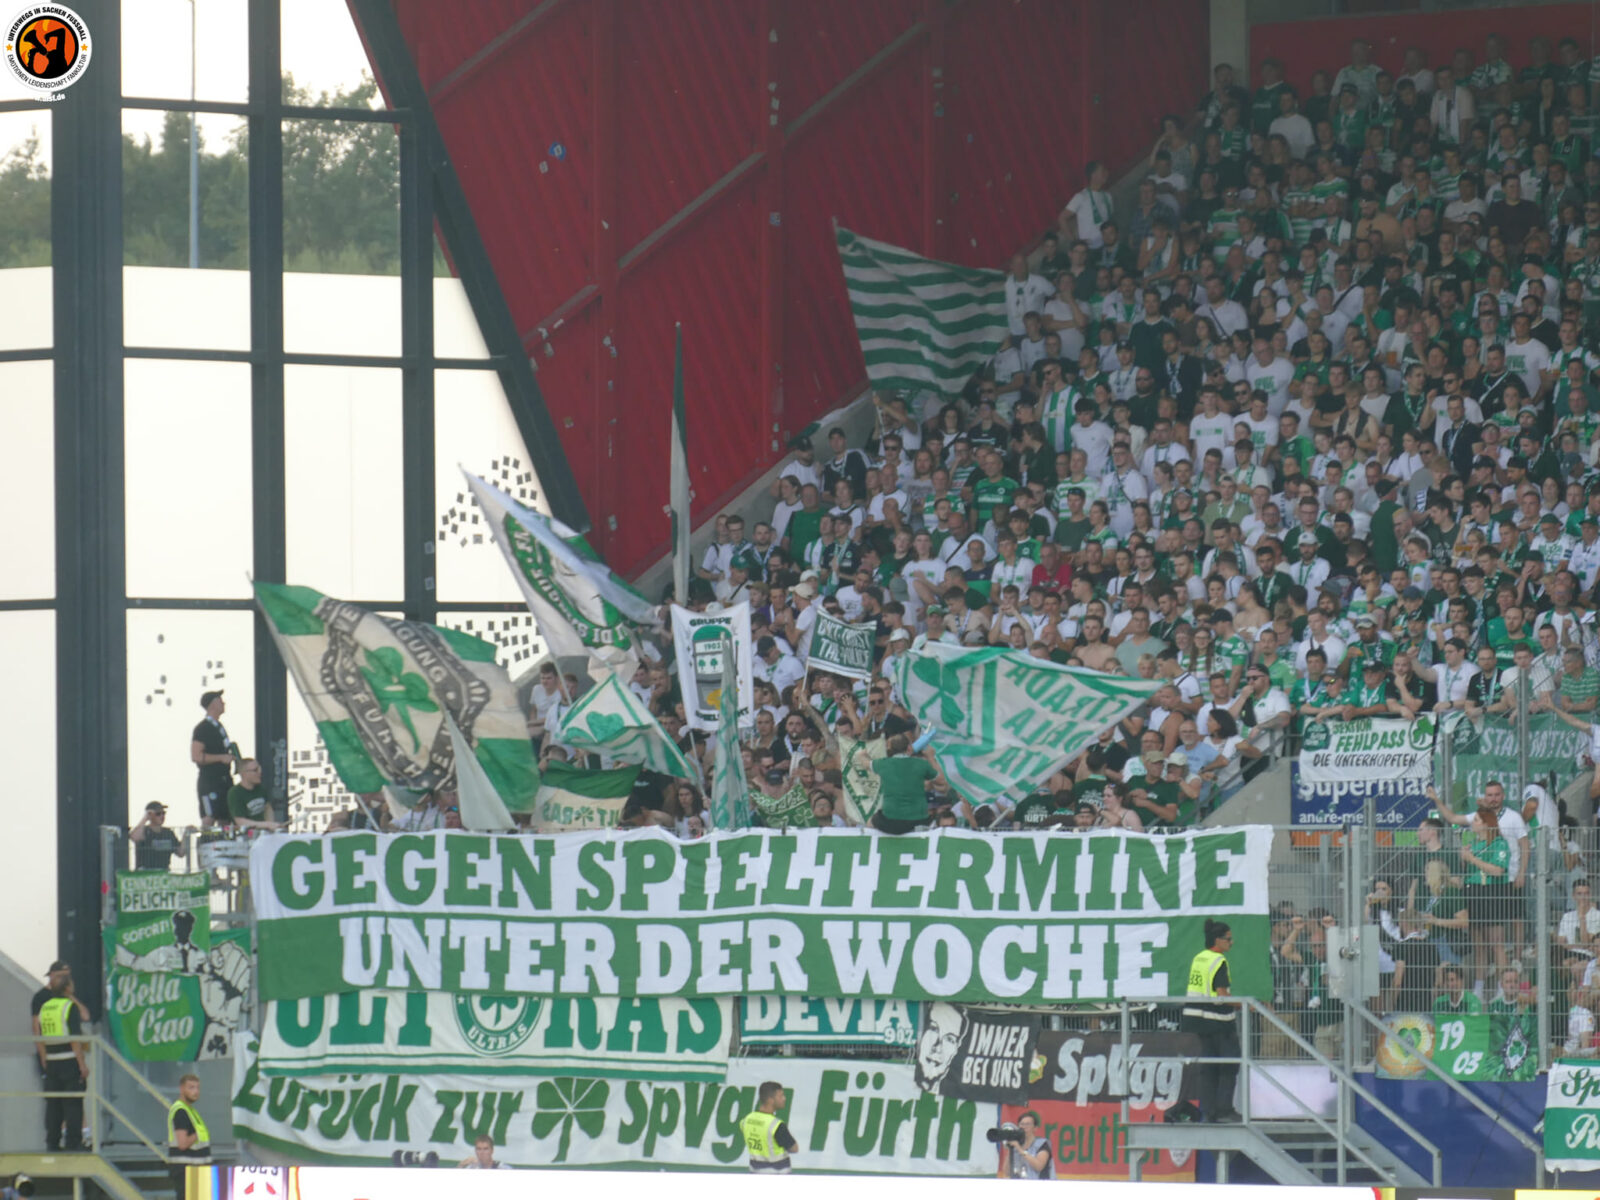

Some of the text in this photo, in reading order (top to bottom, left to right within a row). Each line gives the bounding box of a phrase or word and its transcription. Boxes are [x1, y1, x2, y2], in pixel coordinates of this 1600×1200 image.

[689, 617, 732, 627] GRUPPE
[1335, 730, 1406, 753] FEHLPASS
[1313, 753, 1332, 767] DIE
[271, 831, 1247, 911] GEGEN SPIELTERMINE
[122, 891, 176, 910] PFLICHT
[339, 917, 1169, 999] UNTER DER WOCHE
[116, 973, 181, 1014] Bella
[138, 1008, 194, 1046] Ciao
[467, 1023, 528, 1050] ULTRAS
[968, 1023, 1030, 1059] IMMER
[1439, 1020, 1466, 1051] 19
[962, 1057, 1024, 1089] BEI UNS
[1053, 1038, 1184, 1110] SpVgg
[1452, 1051, 1484, 1076] 03
[431, 1090, 525, 1147] zur
[809, 1069, 977, 1162] Fürth
